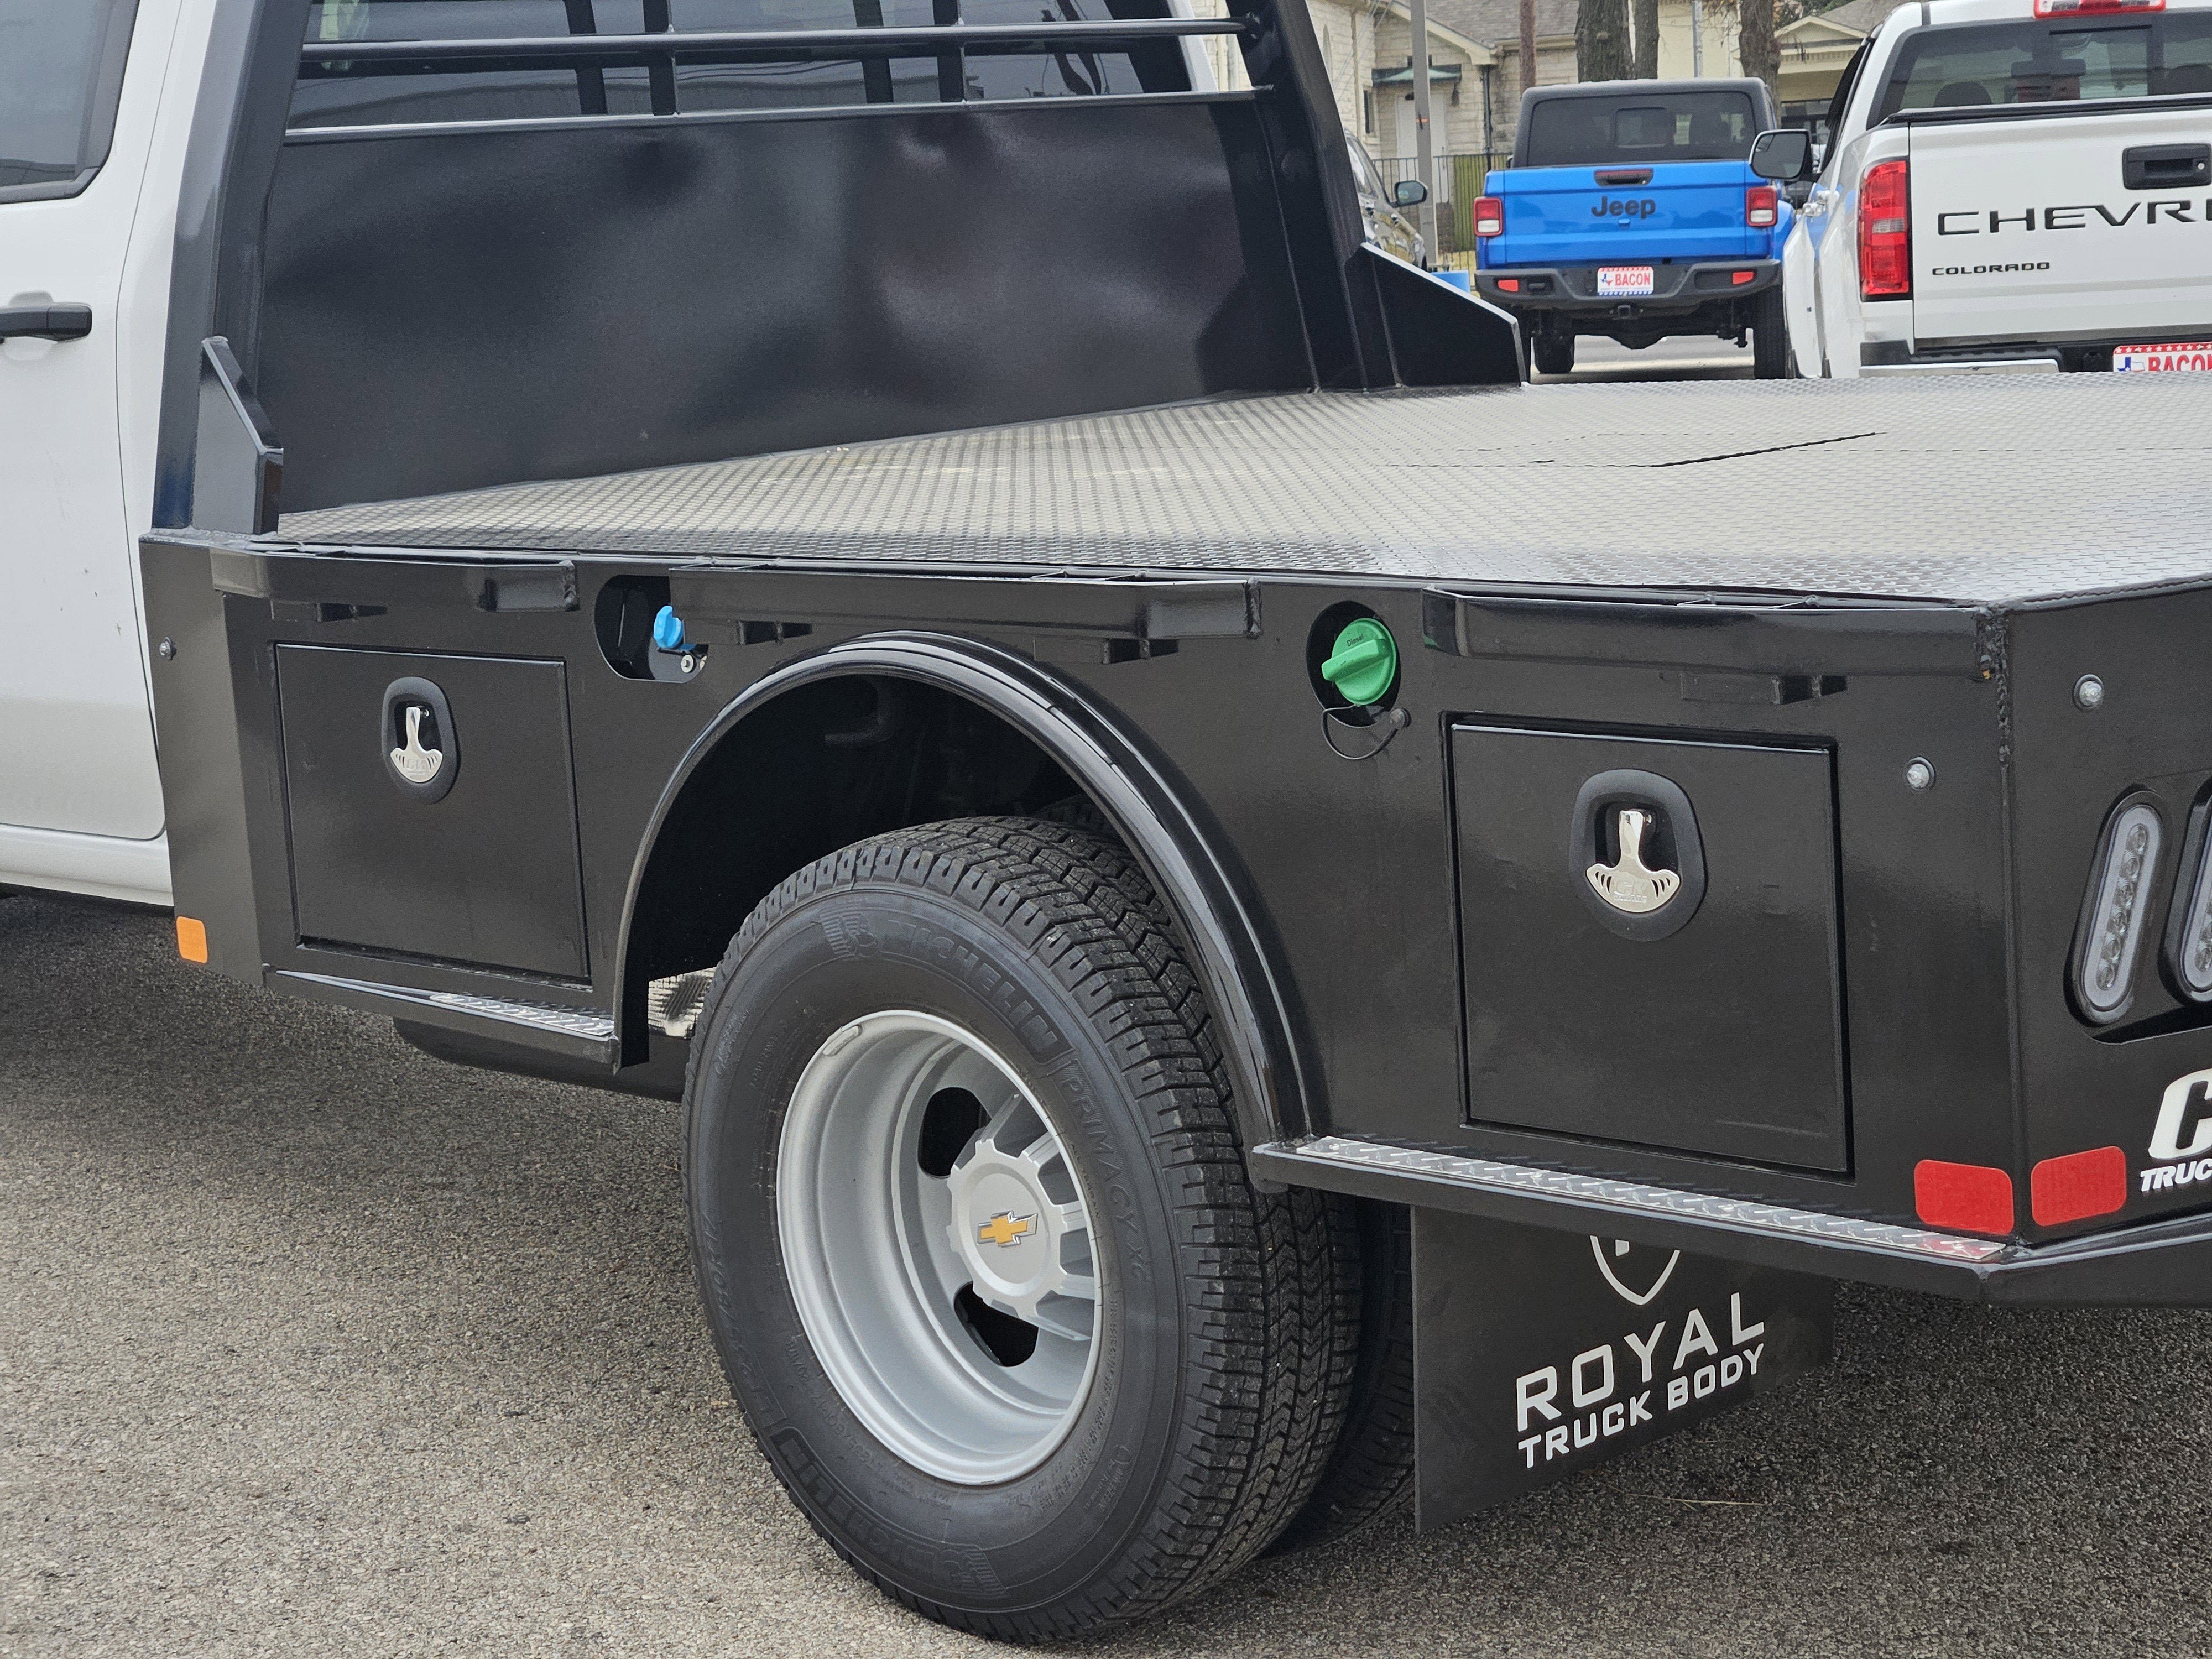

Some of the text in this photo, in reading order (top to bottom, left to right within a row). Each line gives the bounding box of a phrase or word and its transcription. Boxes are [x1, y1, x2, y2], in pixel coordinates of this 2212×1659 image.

[1591, 196, 1656, 219] Jeep
[1938, 199, 2212, 235] CHEVR
[1615, 273, 1651, 285] BACON
[1932, 262, 2051, 275] COLORADO
[2148, 354, 2212, 372] BACO
[1346, 634, 1365, 648] Diesel
[1062, 1076, 1139, 1233] PRIMACY
[1516, 1292, 1765, 1432] ROYAL
[1518, 1343, 1764, 1469] TRUCK BODY
